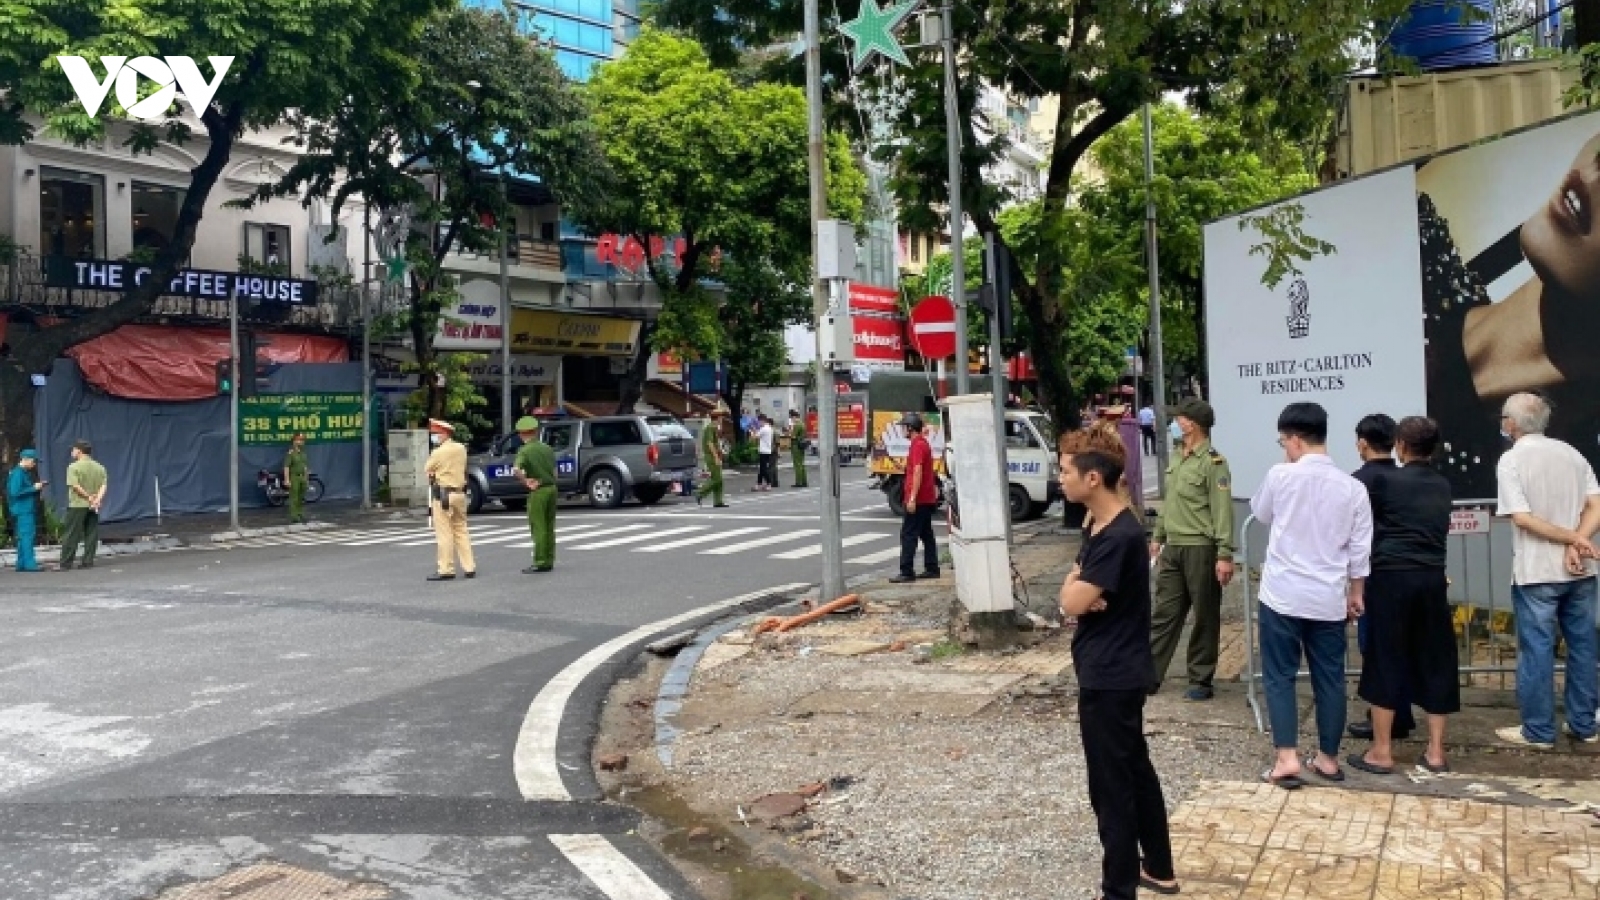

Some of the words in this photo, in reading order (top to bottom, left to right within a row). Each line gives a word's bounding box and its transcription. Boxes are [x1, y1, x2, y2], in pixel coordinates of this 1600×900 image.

[75, 262, 123, 287] THE
[135, 266, 228, 296] CFFEE
[235, 275, 303, 302] HOUSE
[1238, 363, 1262, 378] THE
[1261, 375, 1345, 394] RESIDENCES
[277, 411, 321, 431] PHỐ
